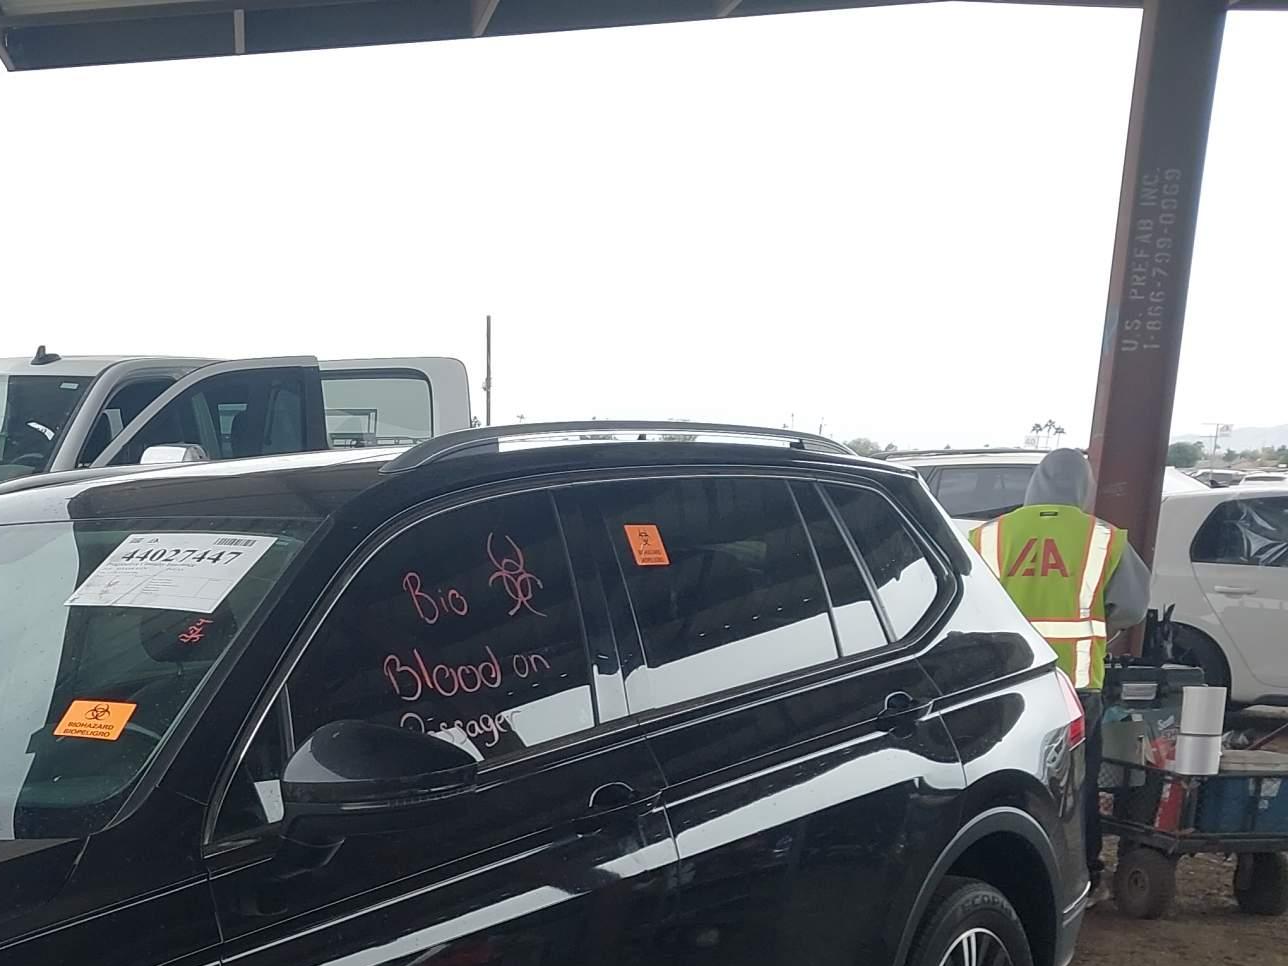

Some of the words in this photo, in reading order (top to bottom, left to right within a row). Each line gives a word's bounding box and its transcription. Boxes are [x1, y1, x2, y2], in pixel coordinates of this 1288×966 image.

[1128, 219, 1153, 300] PREFAB
[122, 548, 243, 565] 44027447
[403, 572, 468, 624] Bio
[383, 646, 501, 701] Blood
[513, 654, 550, 678] on
[63, 728, 111, 737] BIOPELIGRO
[68, 721, 114, 731] BIOHAZARD
